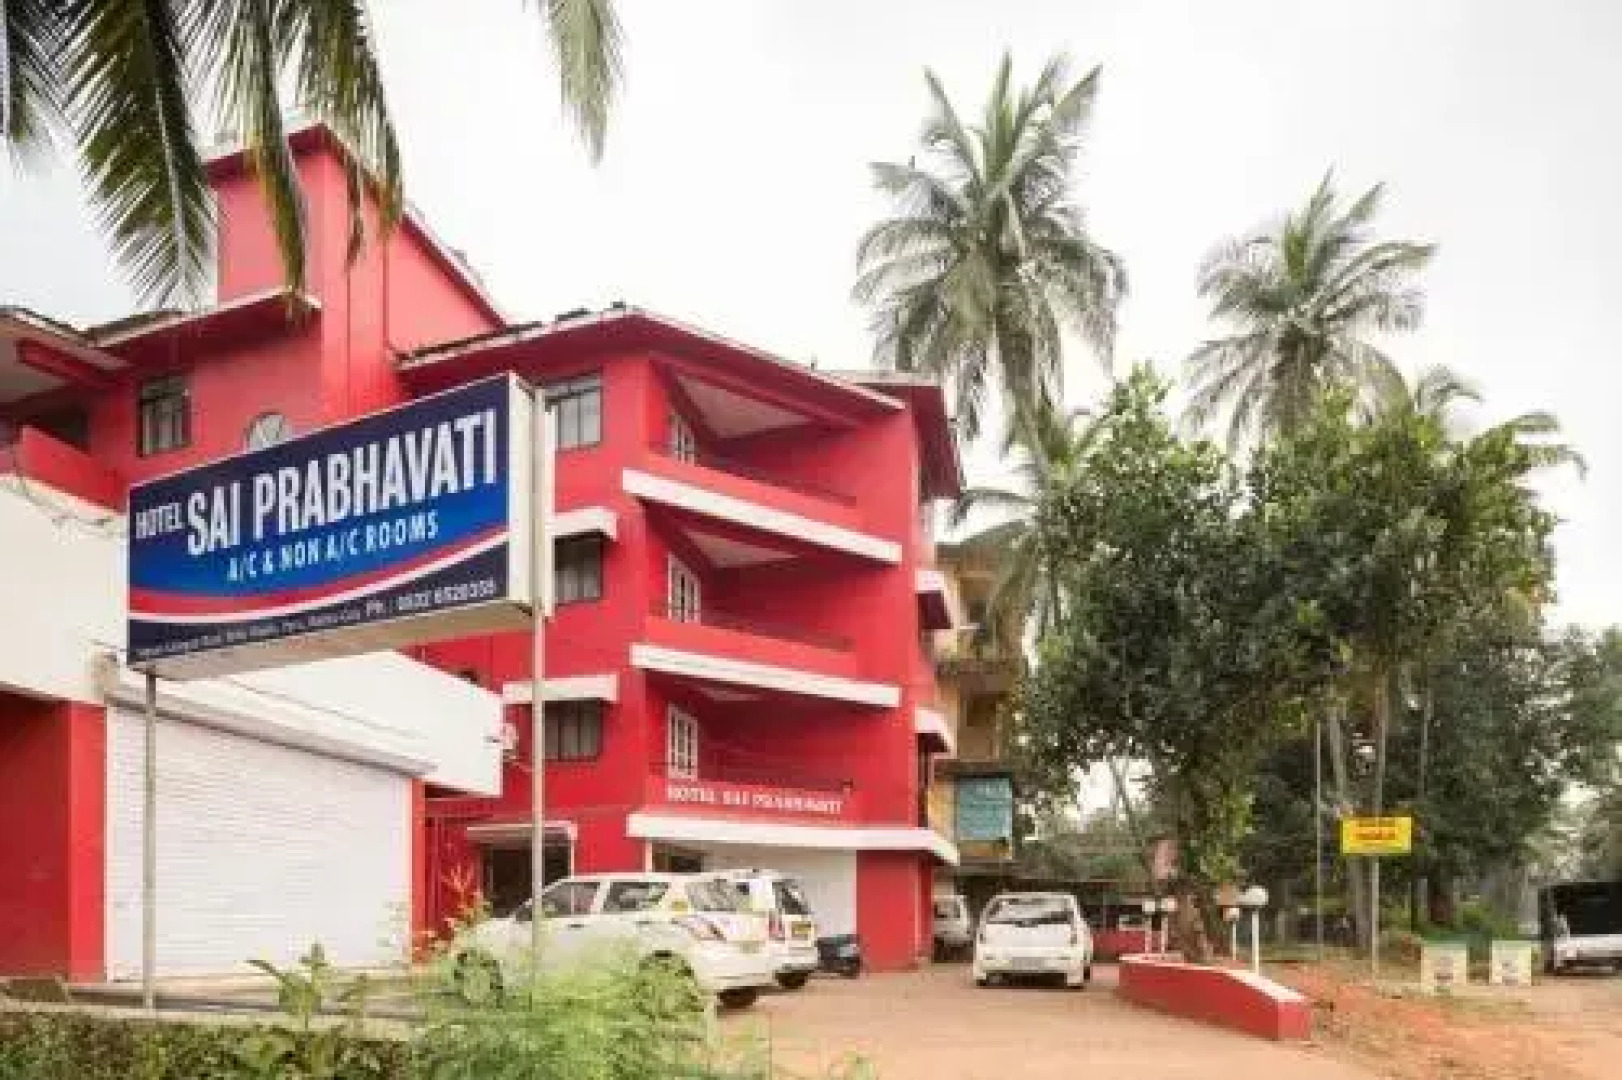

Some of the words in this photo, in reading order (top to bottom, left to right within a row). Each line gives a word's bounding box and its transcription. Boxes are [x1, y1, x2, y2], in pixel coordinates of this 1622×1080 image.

[135, 502, 184, 539] HOTEL
[187, 480, 241, 556] SAI
[252, 408, 497, 541] PRABHAVATI
[227, 550, 258, 582] A/C
[262, 548, 274, 575] &
[279, 537, 320, 572] NON
[326, 526, 359, 562] A/C
[365, 508, 439, 552] ROOMS
